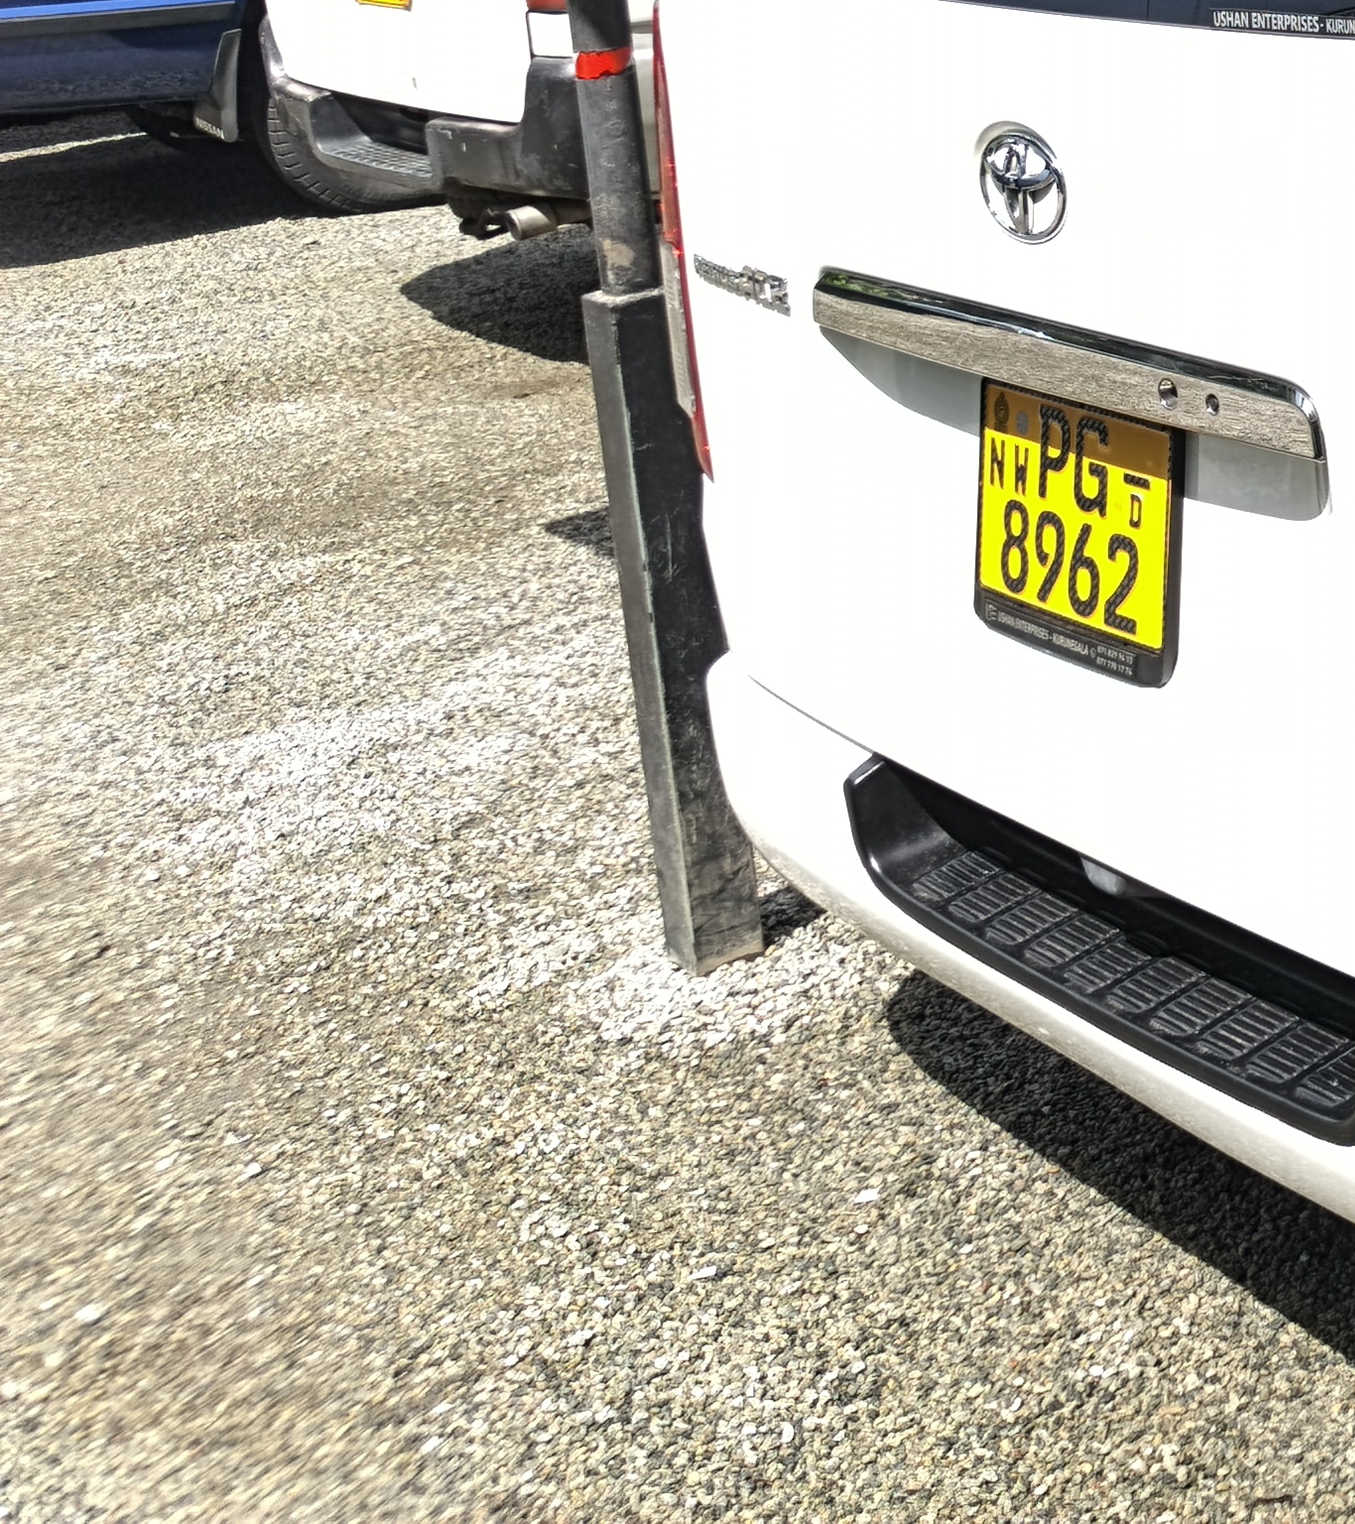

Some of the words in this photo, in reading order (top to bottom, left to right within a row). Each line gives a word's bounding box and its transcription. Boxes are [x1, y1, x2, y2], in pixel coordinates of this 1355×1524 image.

[1213, 10, 1249, 28] USHAN
[990, 437, 1029, 497] NW
[1000, 498, 1139, 636] 8962
